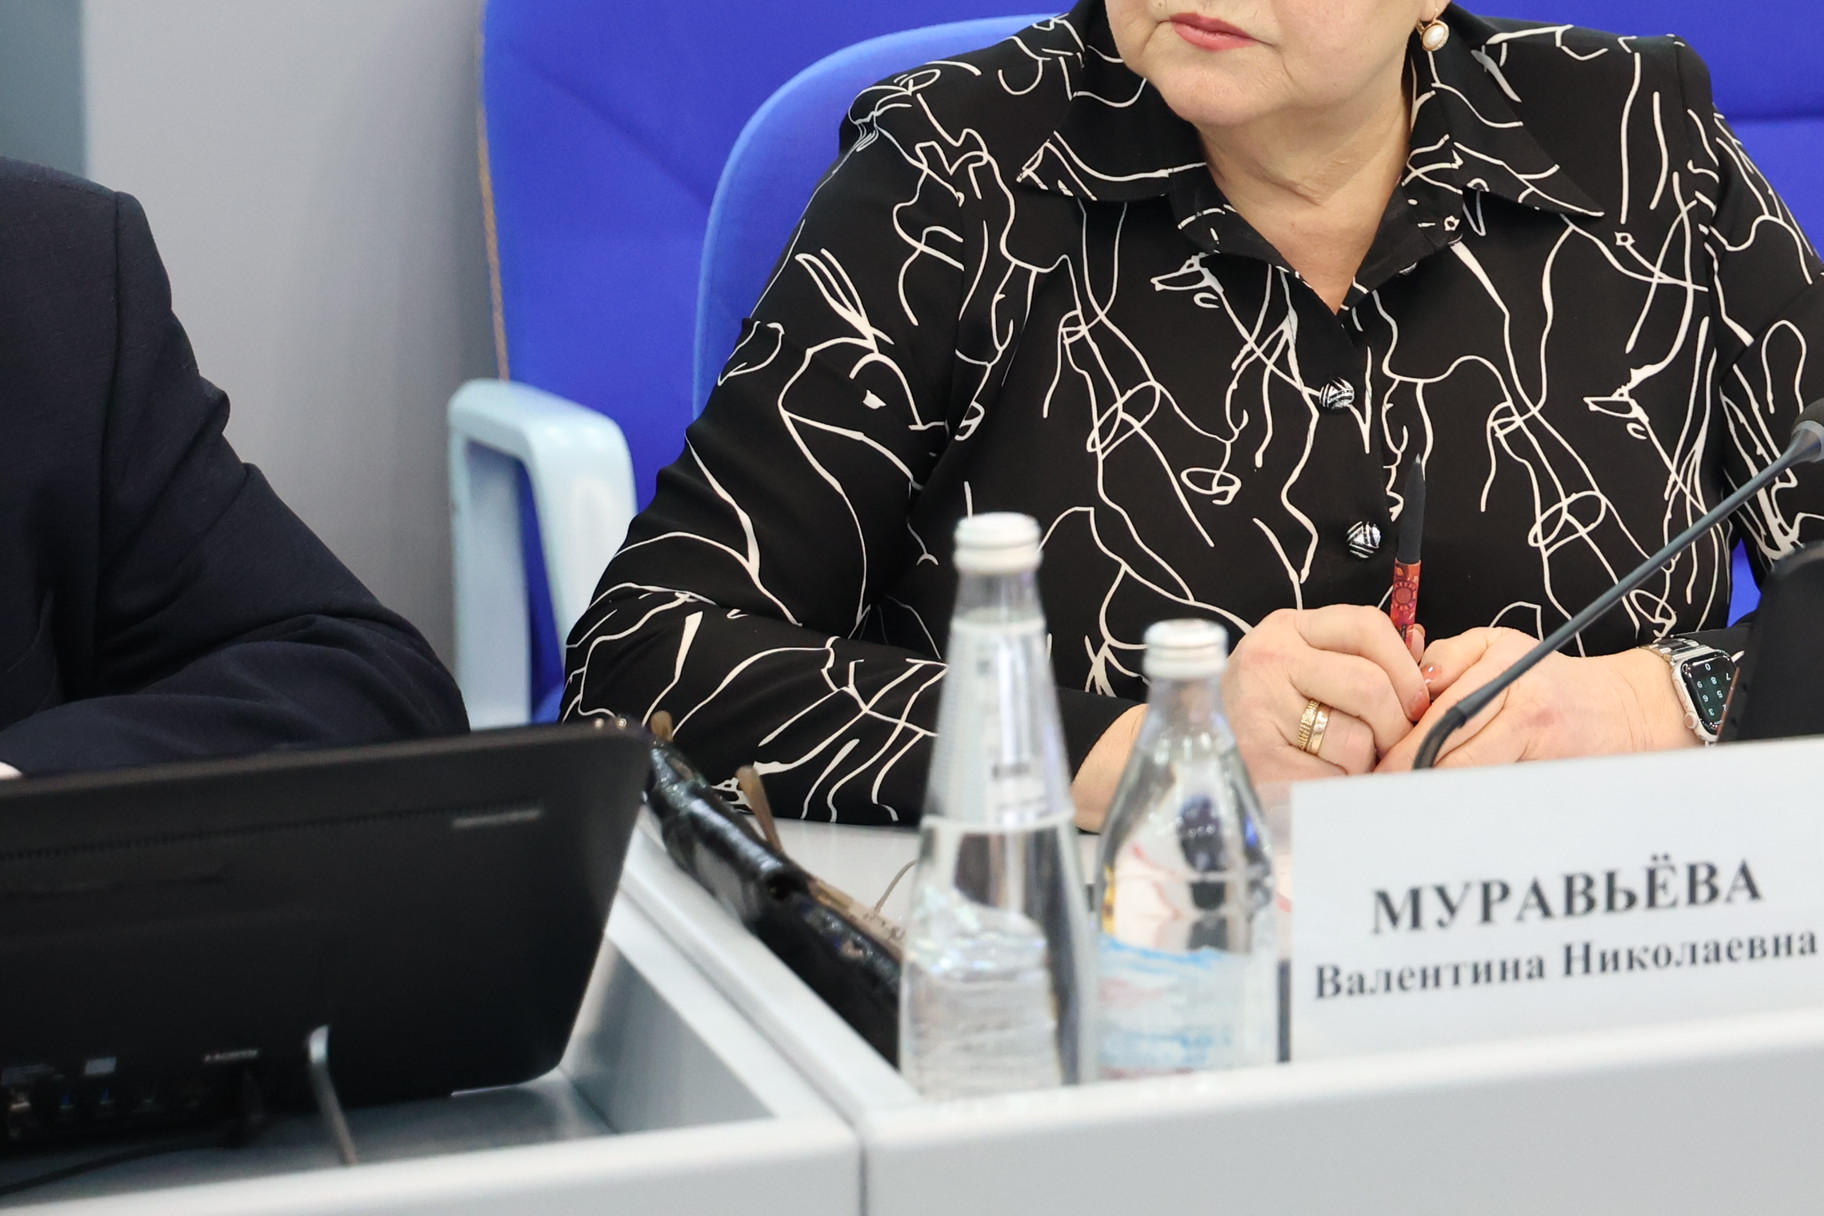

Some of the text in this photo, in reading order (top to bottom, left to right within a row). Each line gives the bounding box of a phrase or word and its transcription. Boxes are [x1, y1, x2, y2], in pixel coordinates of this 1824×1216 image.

[1704, 662, 1711, 671] 0
[1696, 672, 1731, 689] 7 8 9
[1702, 690, 1723, 703] 5 6
[1708, 708, 1715, 716] 3
[1373, 854, 1763, 934] МУРАВЬЁВА
[1315, 931, 1818, 1000] Валентина Николаевна
